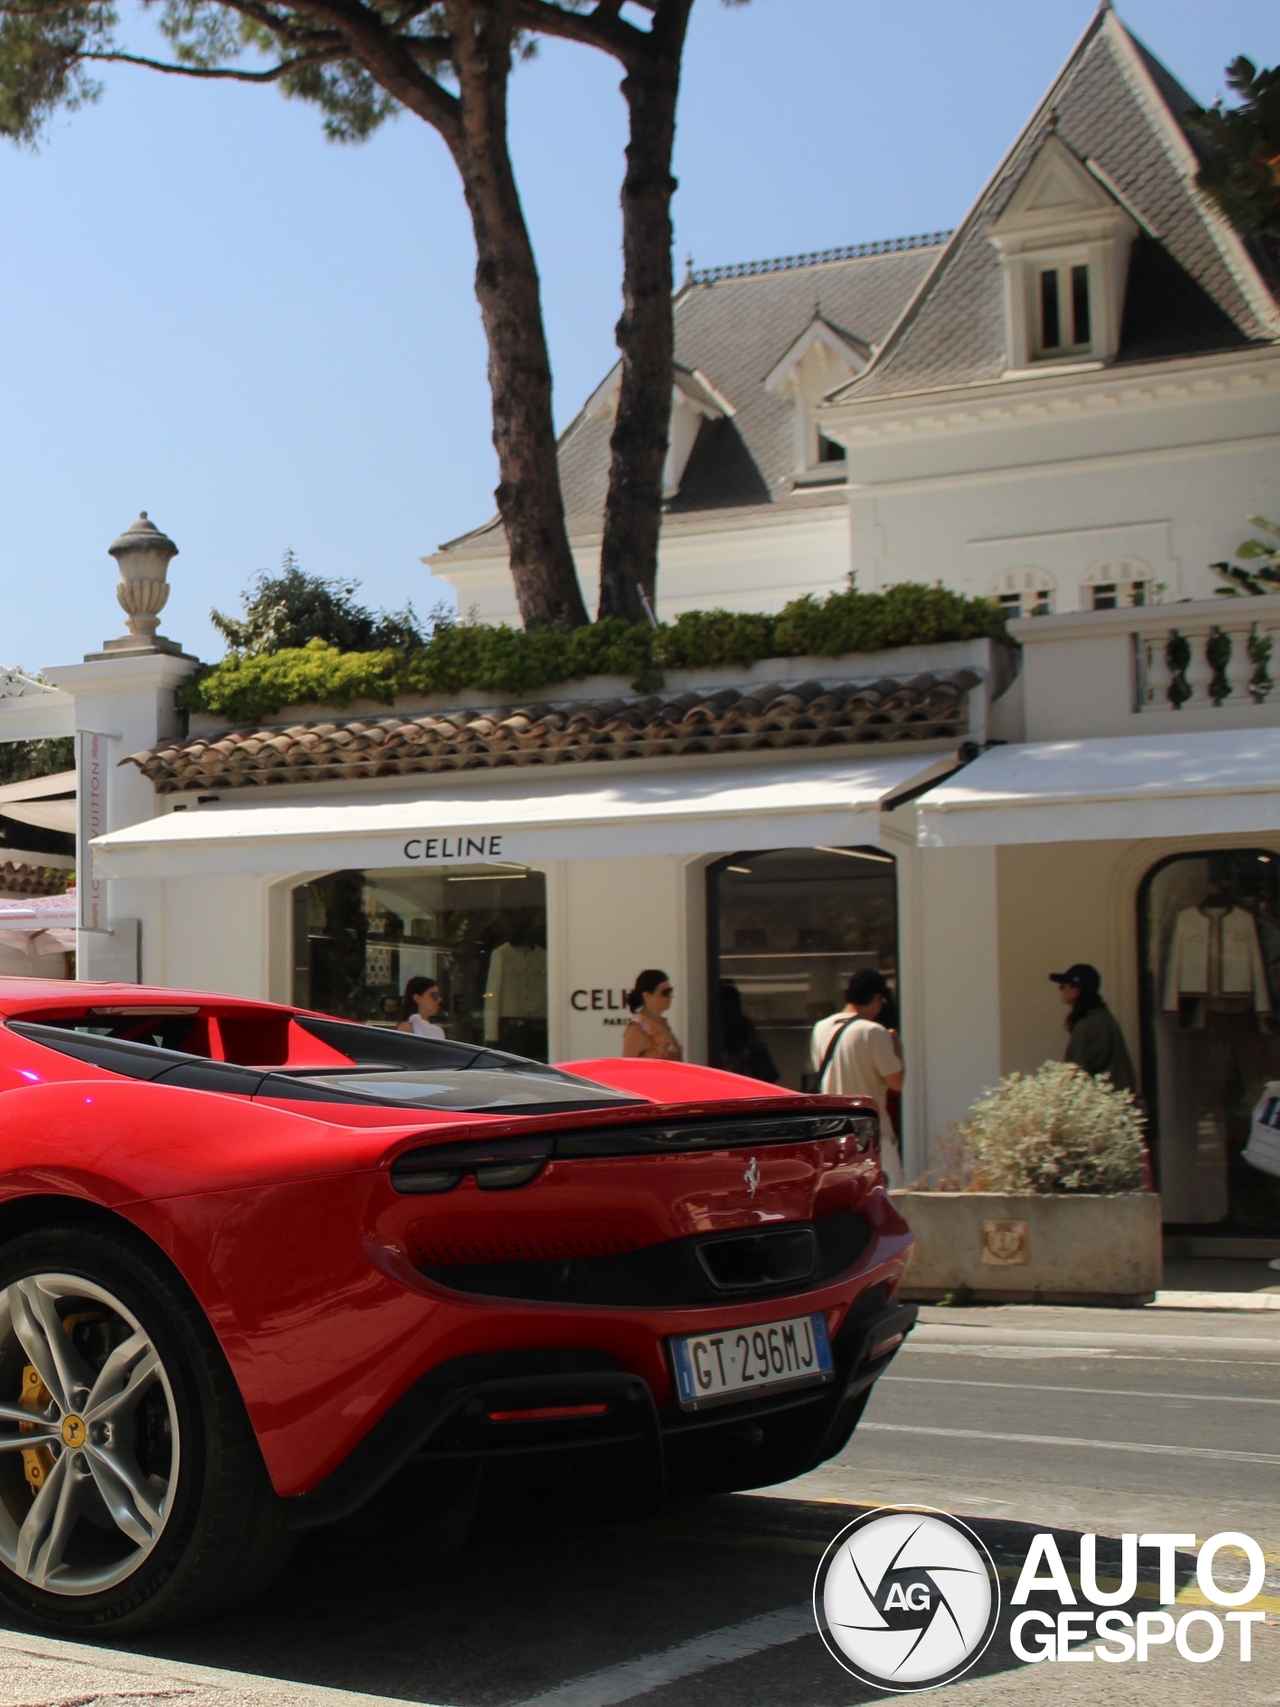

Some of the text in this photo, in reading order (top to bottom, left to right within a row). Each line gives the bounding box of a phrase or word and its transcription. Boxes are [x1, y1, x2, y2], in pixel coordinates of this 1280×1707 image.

[91, 762, 100, 839] VUITTON
[403, 835, 503, 860] CELINE
[571, 989, 634, 1011] CELI
[692, 1321, 814, 1390] GT 296MJ
